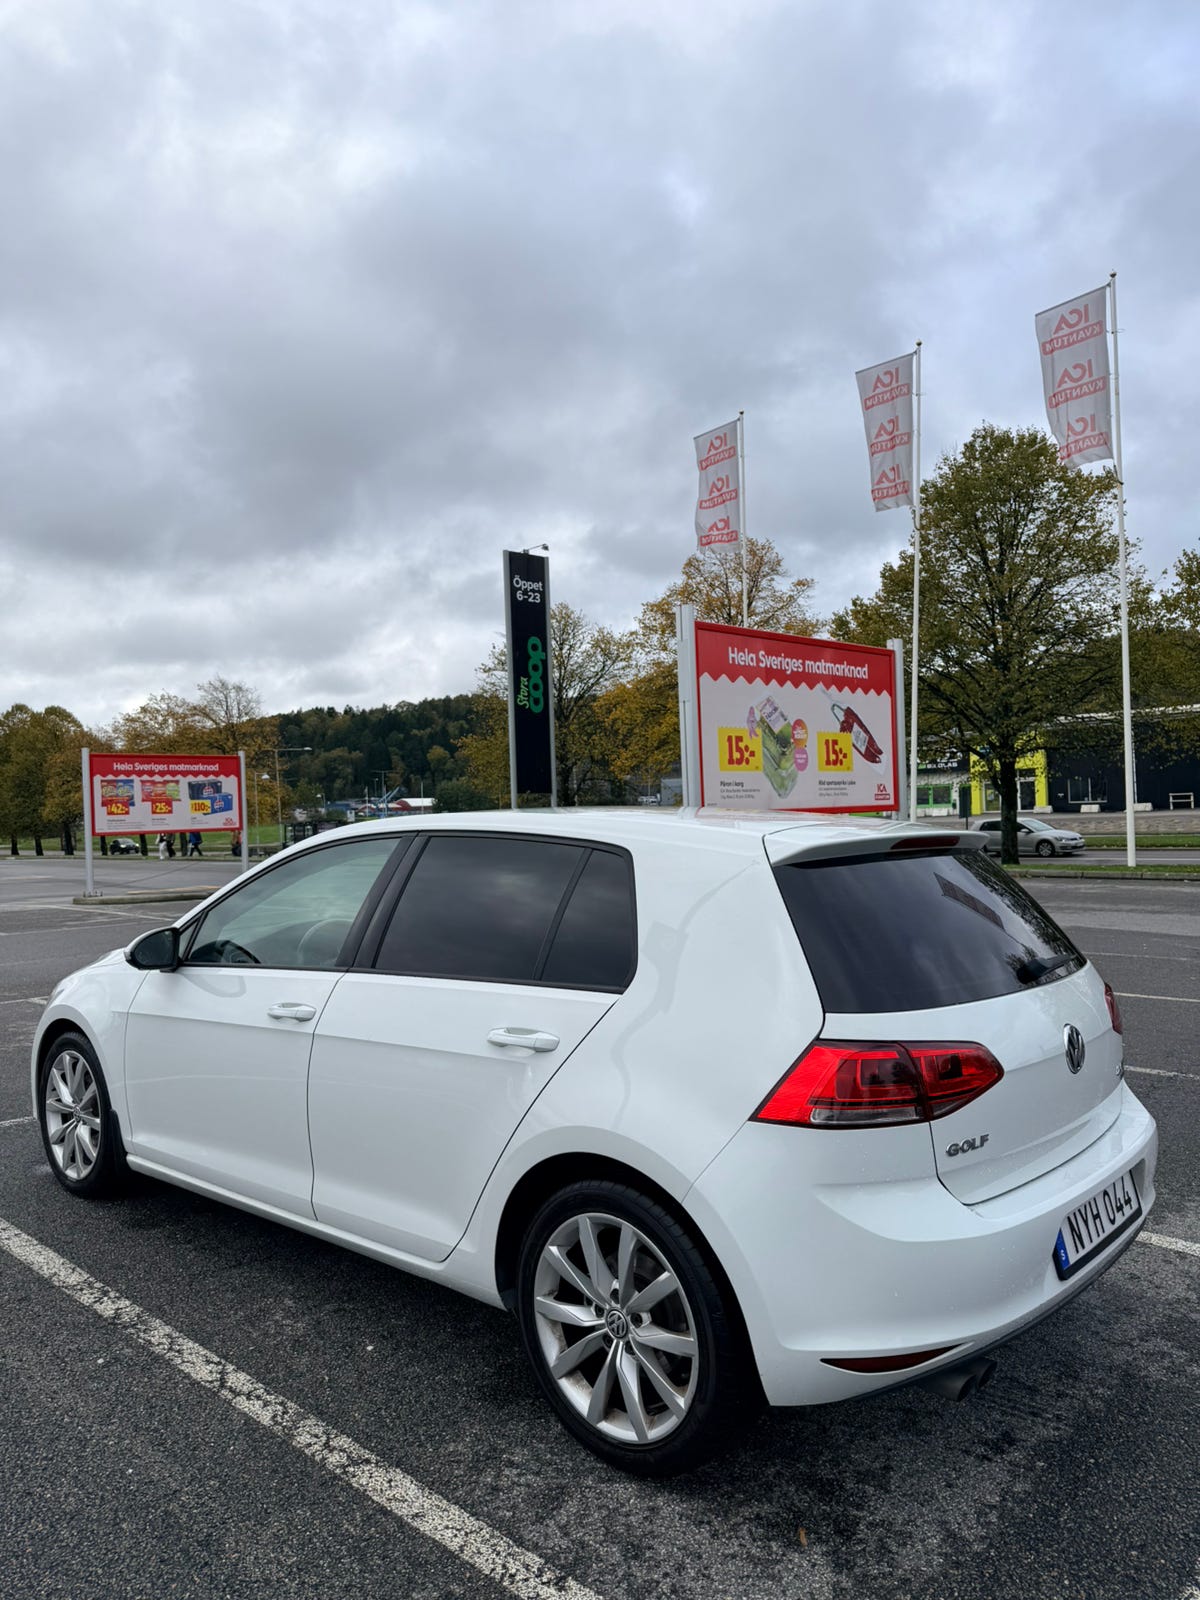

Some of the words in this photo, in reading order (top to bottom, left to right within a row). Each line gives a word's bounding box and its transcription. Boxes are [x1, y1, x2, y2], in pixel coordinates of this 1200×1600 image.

[513, 575, 543, 591] Öppet
[516, 591, 541, 603] 6-23
[527, 636, 546, 713] coop
[728, 647, 757, 667] Hela
[759, 650, 803, 675] Sveriges
[805, 659, 869, 679] matmarknad
[517, 677, 530, 709] Stora
[727, 735, 755, 765] 15:-
[824, 739, 848, 766] 15:-
[113, 762, 133, 771] Hela
[134, 762, 168, 772] Sveriges
[169, 763, 219, 771] matmarknad
[946, 1134, 989, 1157] GOLF
[1067, 1196, 1105, 1254] NYH
[1103, 1175, 1133, 1226] 044
